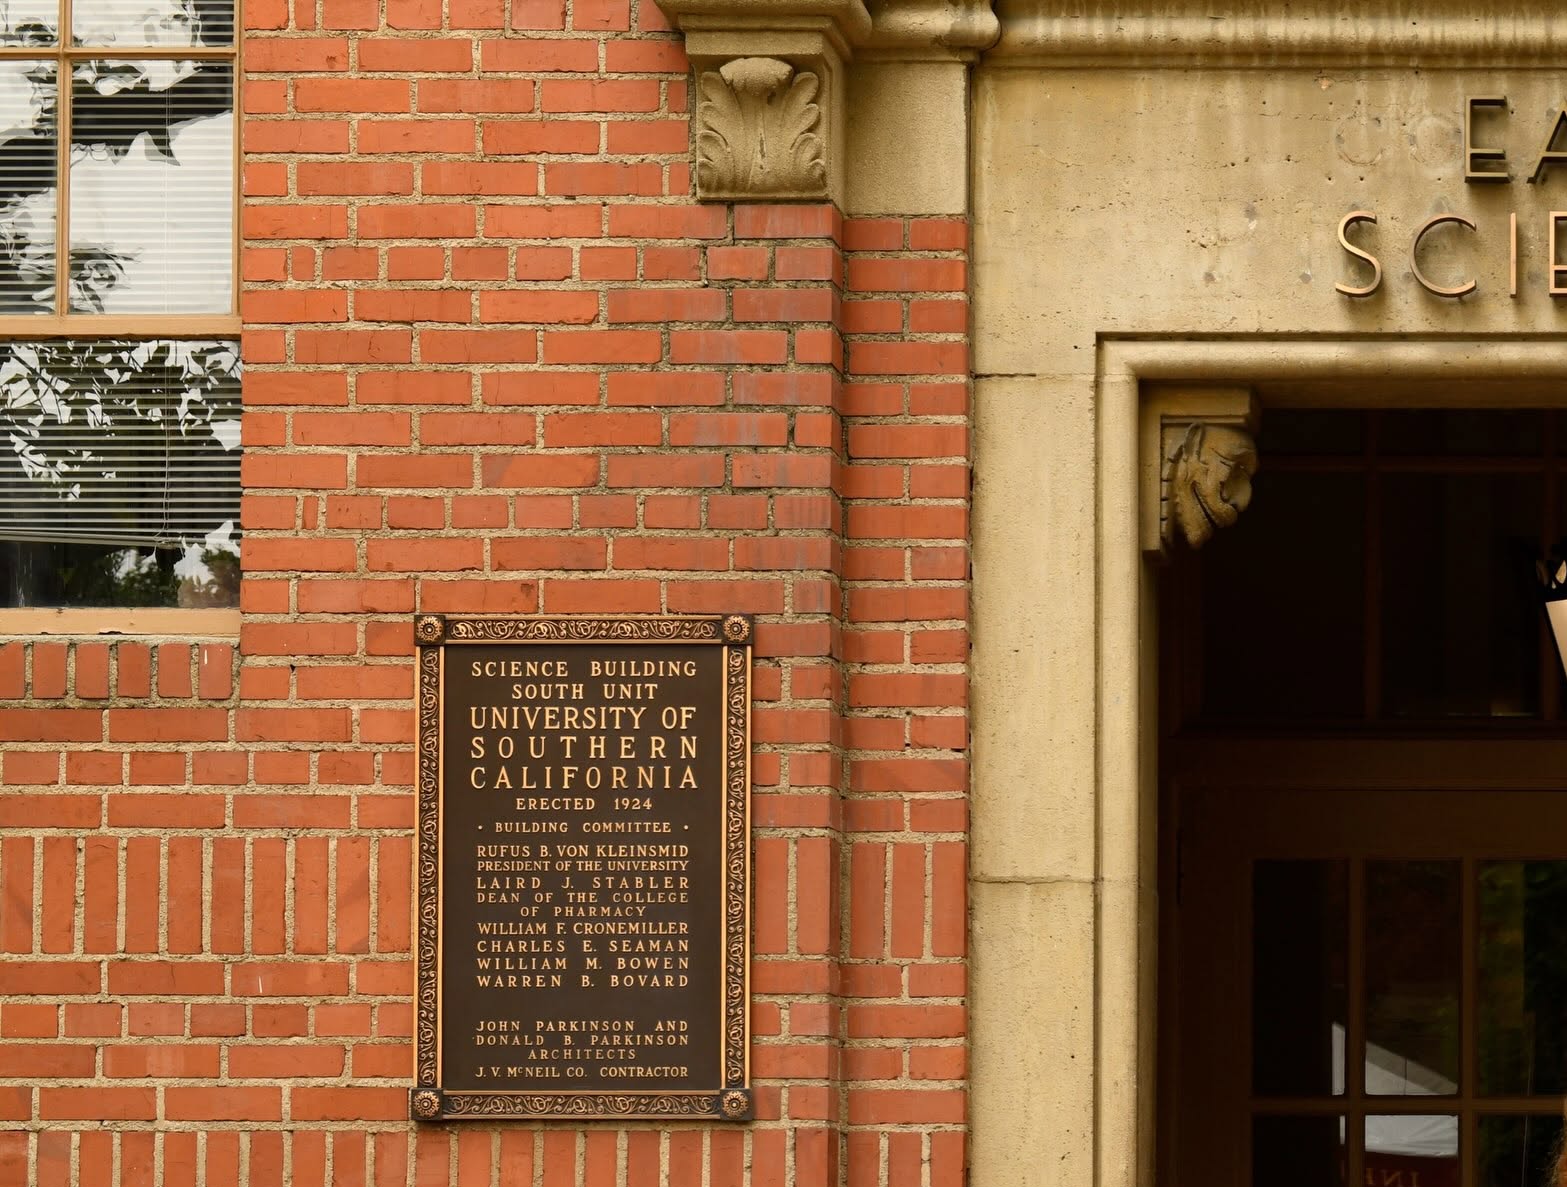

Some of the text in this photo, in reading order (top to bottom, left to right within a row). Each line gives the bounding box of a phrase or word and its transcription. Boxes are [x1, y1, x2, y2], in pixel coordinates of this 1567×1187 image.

[471, 661, 697, 677] SCIENCE BUILDING
[511, 684, 659, 700] SOUTH UNIT
[470, 706, 697, 730] UNIVERSITY OF
[470, 736, 698, 759] SOUTHERN
[470, 766, 699, 789] CALIFORNIA
[516, 797, 653, 810] ERECTED 1924
[495, 822, 672, 833] BUILDING COMMITTEE
[476, 845, 690, 858] RUFUS B. VON KLEINSMID
[476, 860, 690, 871] PRESIDENT OF THE UNIVERSITY
[476, 877, 690, 889] LAIRD J. STABLER
[476, 892, 689, 903] DEAN OF THE COLLEGE
[520, 906, 647, 917] OF PHARMACY
[476, 922, 689, 935] WILLIAM F. CRONEMILLER
[476, 940, 689, 953] CHARLES E. SEAMAN
[476, 958, 690, 970] WILLIAM M. BOWEN
[476, 975, 688, 988] WARREN B. BOVARD
[475, 1021, 688, 1032] JOHN PARKINSON AND
[475, 1035, 689, 1046] DONALD B. PARKINSON
[527, 1049, 637, 1060] ARCHITECTS
[475, 1066, 487, 1078] J.
[491, 1066, 502, 1078] V.
[566, 1066, 588, 1078] CO.
[599, 1066, 688, 1078] CONTRACTOR
